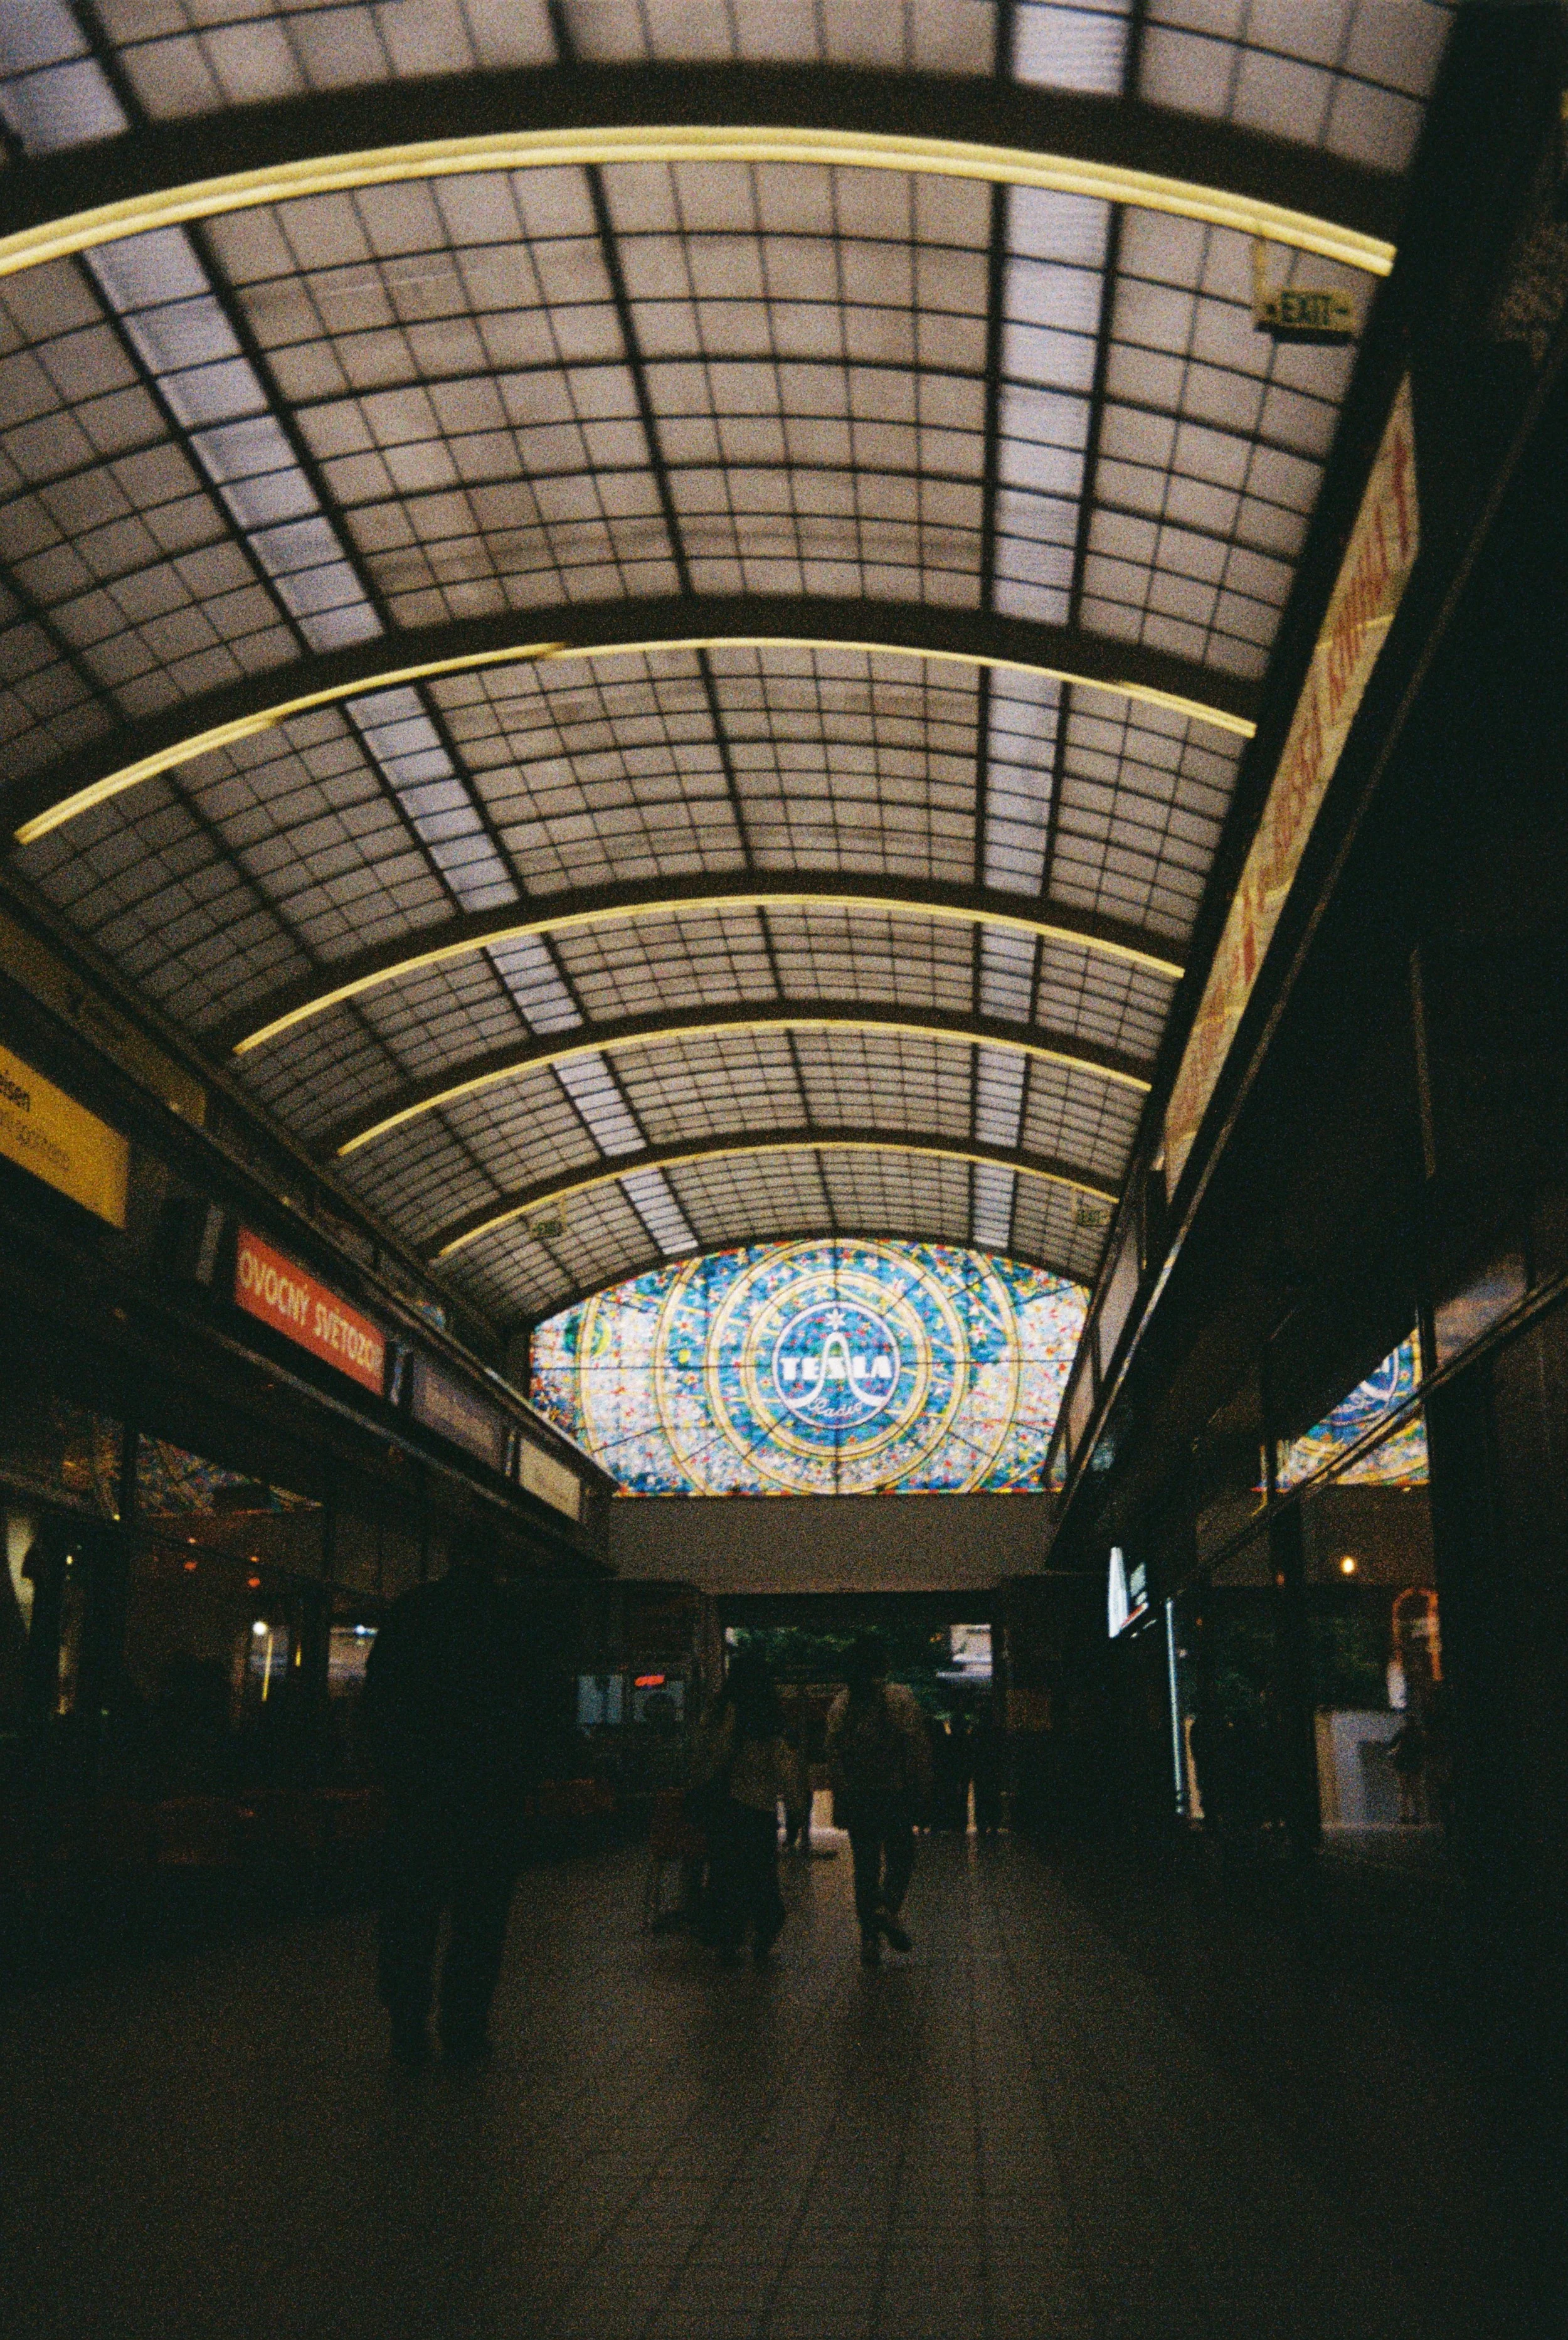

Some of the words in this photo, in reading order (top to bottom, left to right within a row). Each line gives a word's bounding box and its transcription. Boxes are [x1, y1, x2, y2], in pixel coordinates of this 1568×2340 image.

[1281, 290, 1332, 326] EXIT
[240, 1250, 311, 1327] OVOCNÝ
[780, 1355, 892, 1381] TESLA
